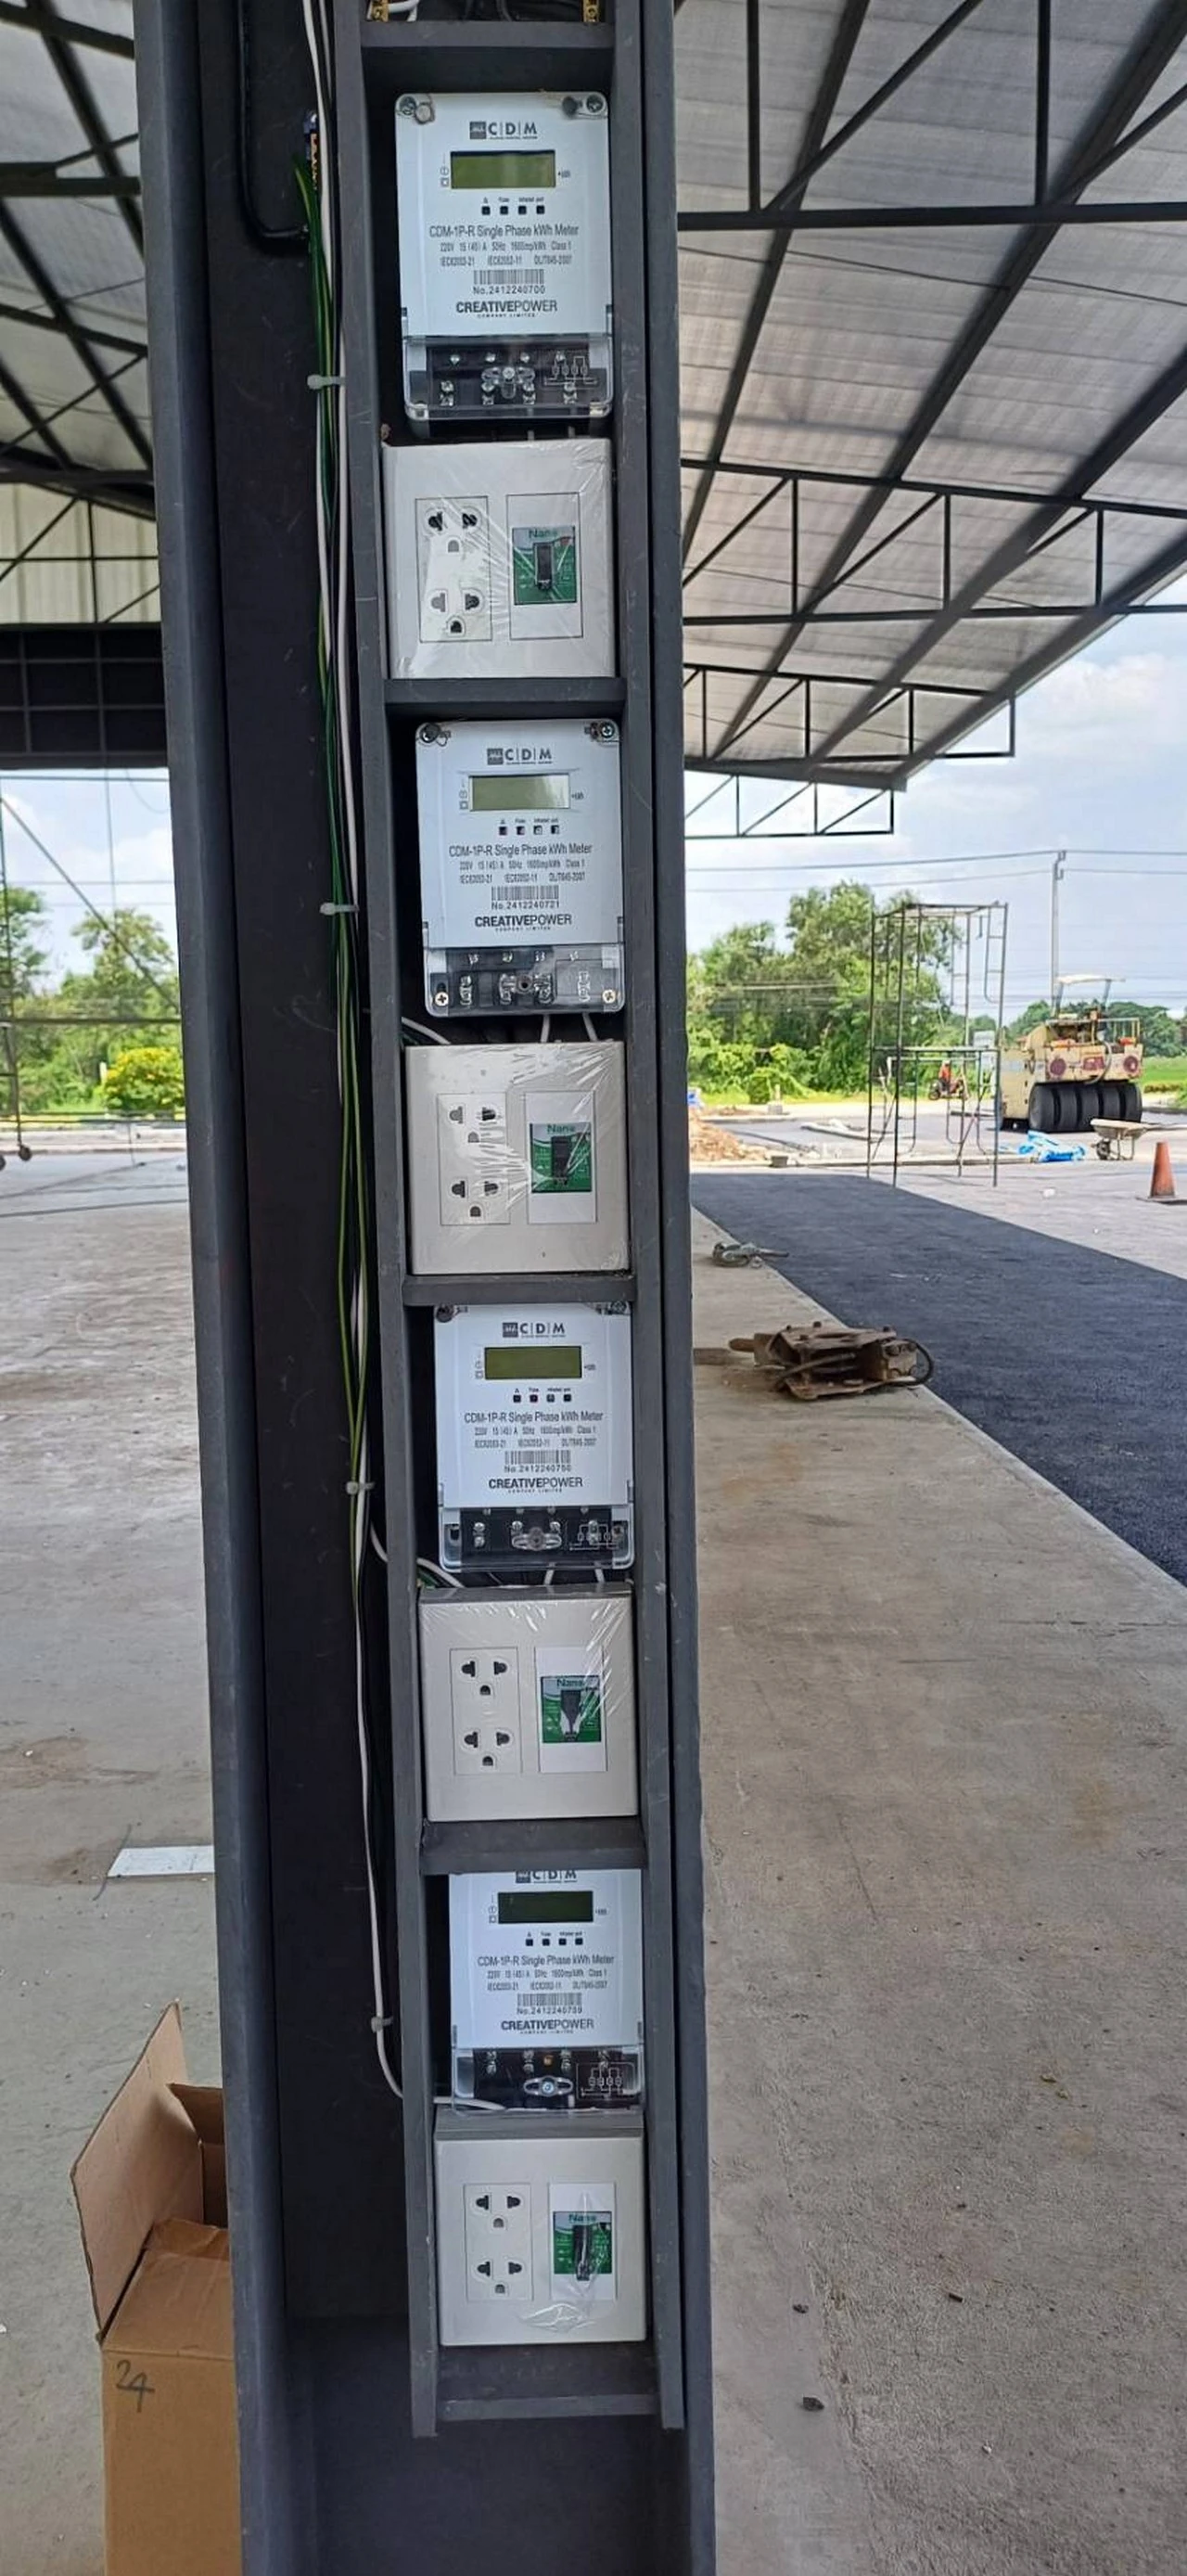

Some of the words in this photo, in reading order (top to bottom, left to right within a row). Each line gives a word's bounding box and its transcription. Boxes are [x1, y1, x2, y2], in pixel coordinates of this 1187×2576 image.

[428, 225, 475, 237] CDM-1P-R
[477, 224, 504, 239] Single
[504, 224, 532, 237] Phase
[533, 224, 553, 237] kWh
[554, 224, 579, 236] Meter
[440, 241, 453, 252] 220V
[551, 240, 567, 250] Class
[455, 300, 557, 314] CREATIVEPOWER
[449, 845, 492, 857] CDM-1P-R
[495, 844, 520, 858] Single
[521, 844, 547, 855] Phase
[549, 843, 568, 854] kWh
[568, 843, 593, 854] Meter
[474, 914, 572, 928] CREATIVEPOWER
[465, 1412, 508, 1423] CDM-1P-R
[508, 1411, 533, 1424] Single
[534, 1411, 559, 1422] Phase
[561, 1411, 579, 1421] kWh
[580, 1411, 604, 1421] Meter
[577, 1426, 592, 1434] Class
[489, 1477, 583, 1490] CREATIVEPOWER
[521, 1954, 545, 1967] Single
[547, 1954, 571, 1965] Phase
[573, 1954, 591, 1964] kWh
[592, 1954, 614, 1964] Meter
[588, 1968, 603, 1977] Class
[501, 2019, 594, 2031] CREATIVEPOWER
[116, 2359, 156, 2413] 24
